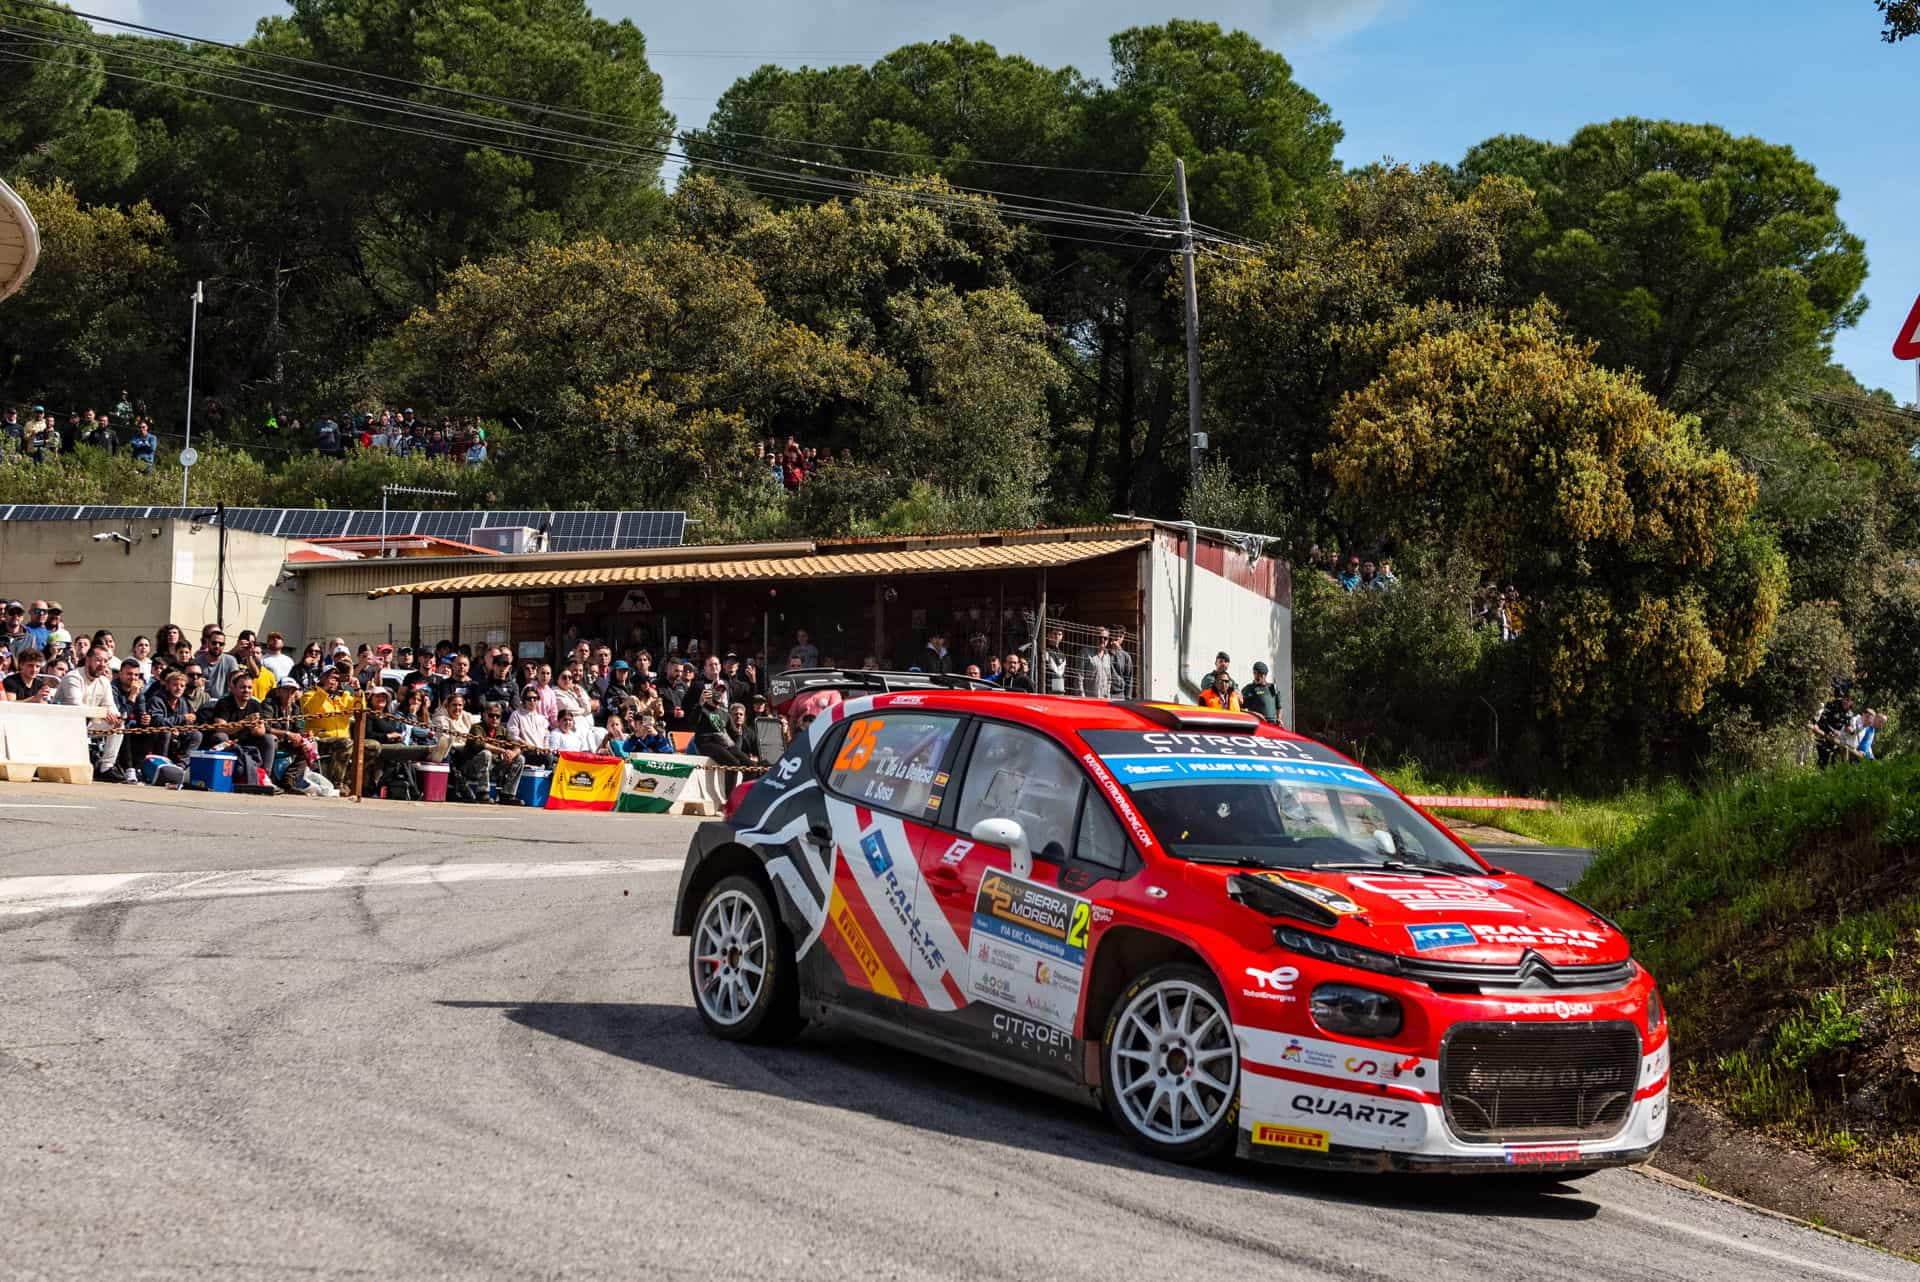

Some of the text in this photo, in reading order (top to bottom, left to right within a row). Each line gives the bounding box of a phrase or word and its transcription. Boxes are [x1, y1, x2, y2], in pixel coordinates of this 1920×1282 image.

[832, 720, 886, 771] 25
[1011, 902, 1065, 930] MORENA
[1024, 890, 1068, 916] SIERRA
[884, 887, 935, 971] TEAM SPAIN
[886, 871, 946, 969] RALLYE
[838, 907, 880, 978] PIRELLI
[1024, 932, 1065, 957] Championship
[1472, 926, 1606, 943] RALLYE
[1482, 935, 1598, 949] TEAM SPAIN
[1242, 988, 1297, 1003] TotalEnergies
[1291, 1094, 1410, 1128] QUARTZ
[1259, 1126, 1324, 1148] PIRELLI
